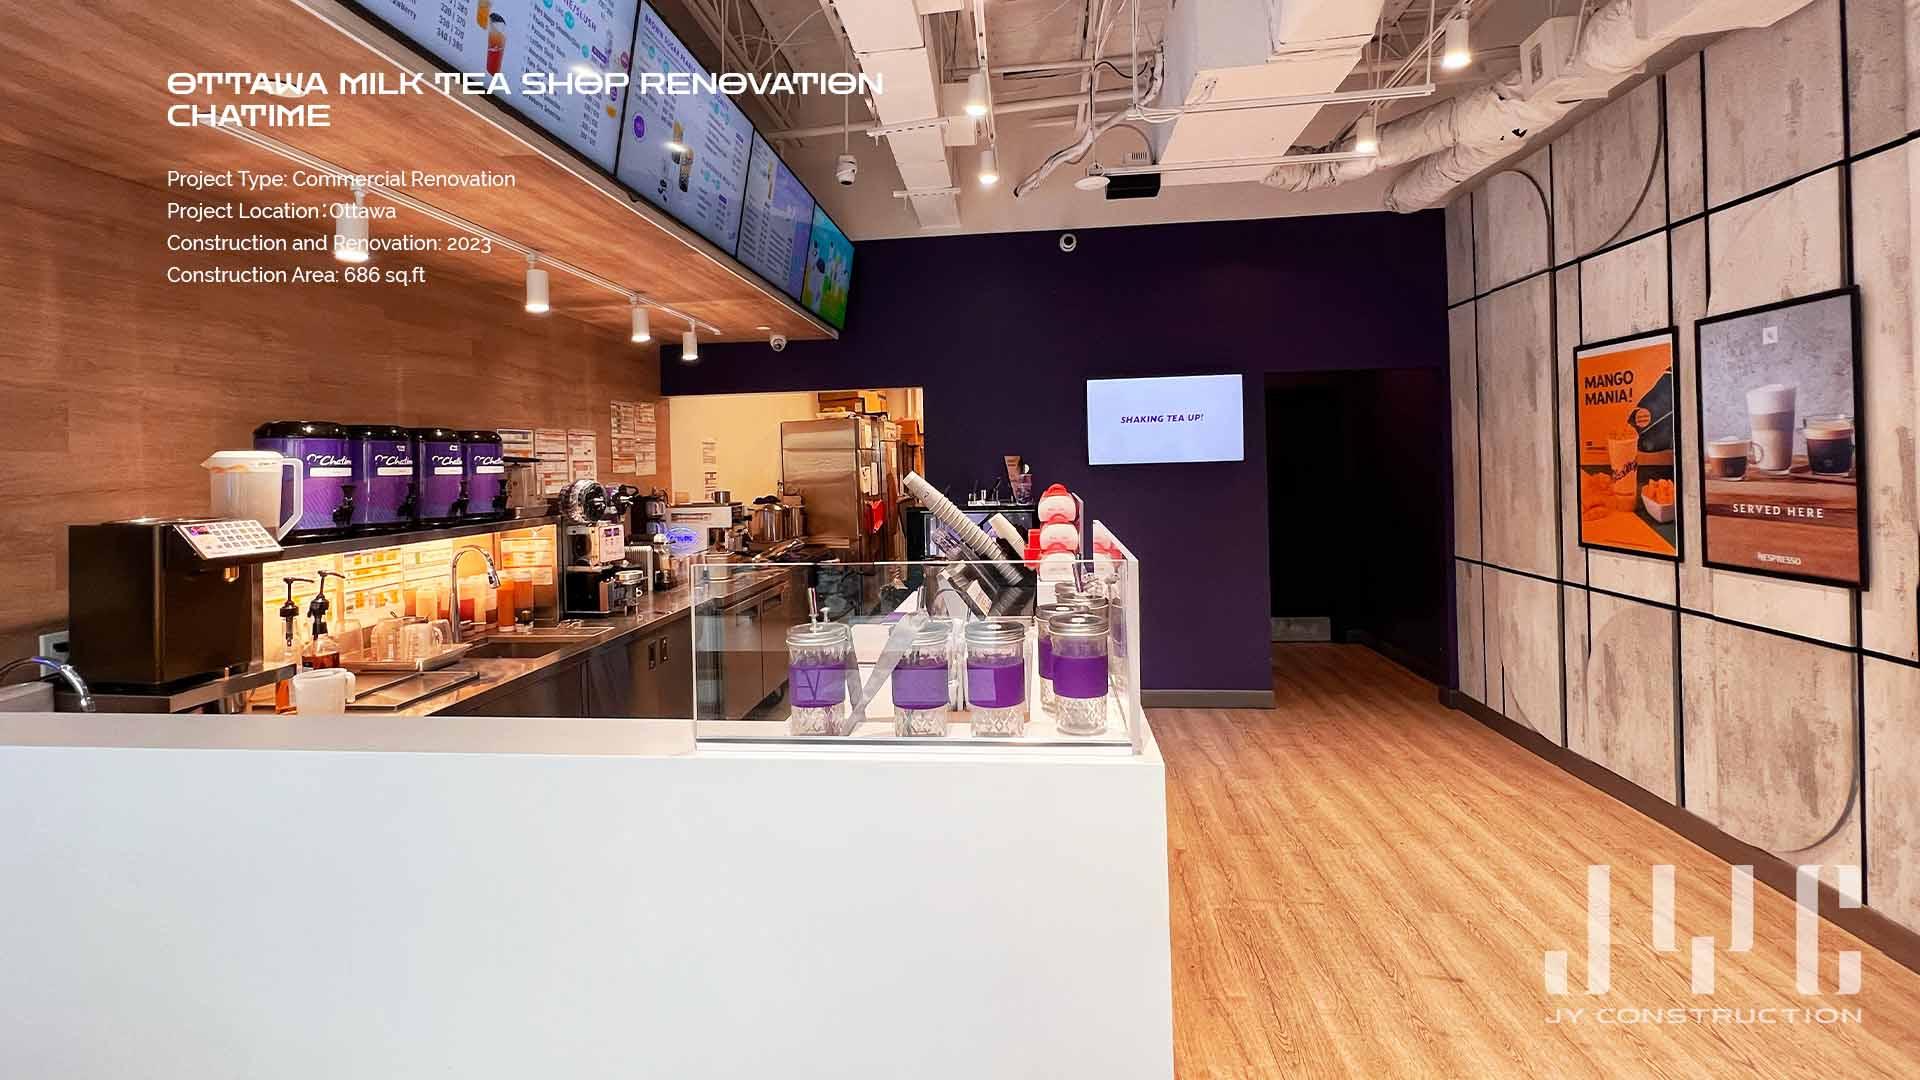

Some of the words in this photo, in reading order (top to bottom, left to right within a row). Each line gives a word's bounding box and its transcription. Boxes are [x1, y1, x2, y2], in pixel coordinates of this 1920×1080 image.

[1584, 370, 1634, 389] MANGO
[1585, 388, 1633, 406] MANIA!
[1120, 415, 1164, 424] SHAKING
[1167, 414, 1185, 423] TEA
[1188, 413, 1204, 422] UP!
[1732, 503, 1781, 516] SERVED
[1787, 506, 1824, 519] HERE
